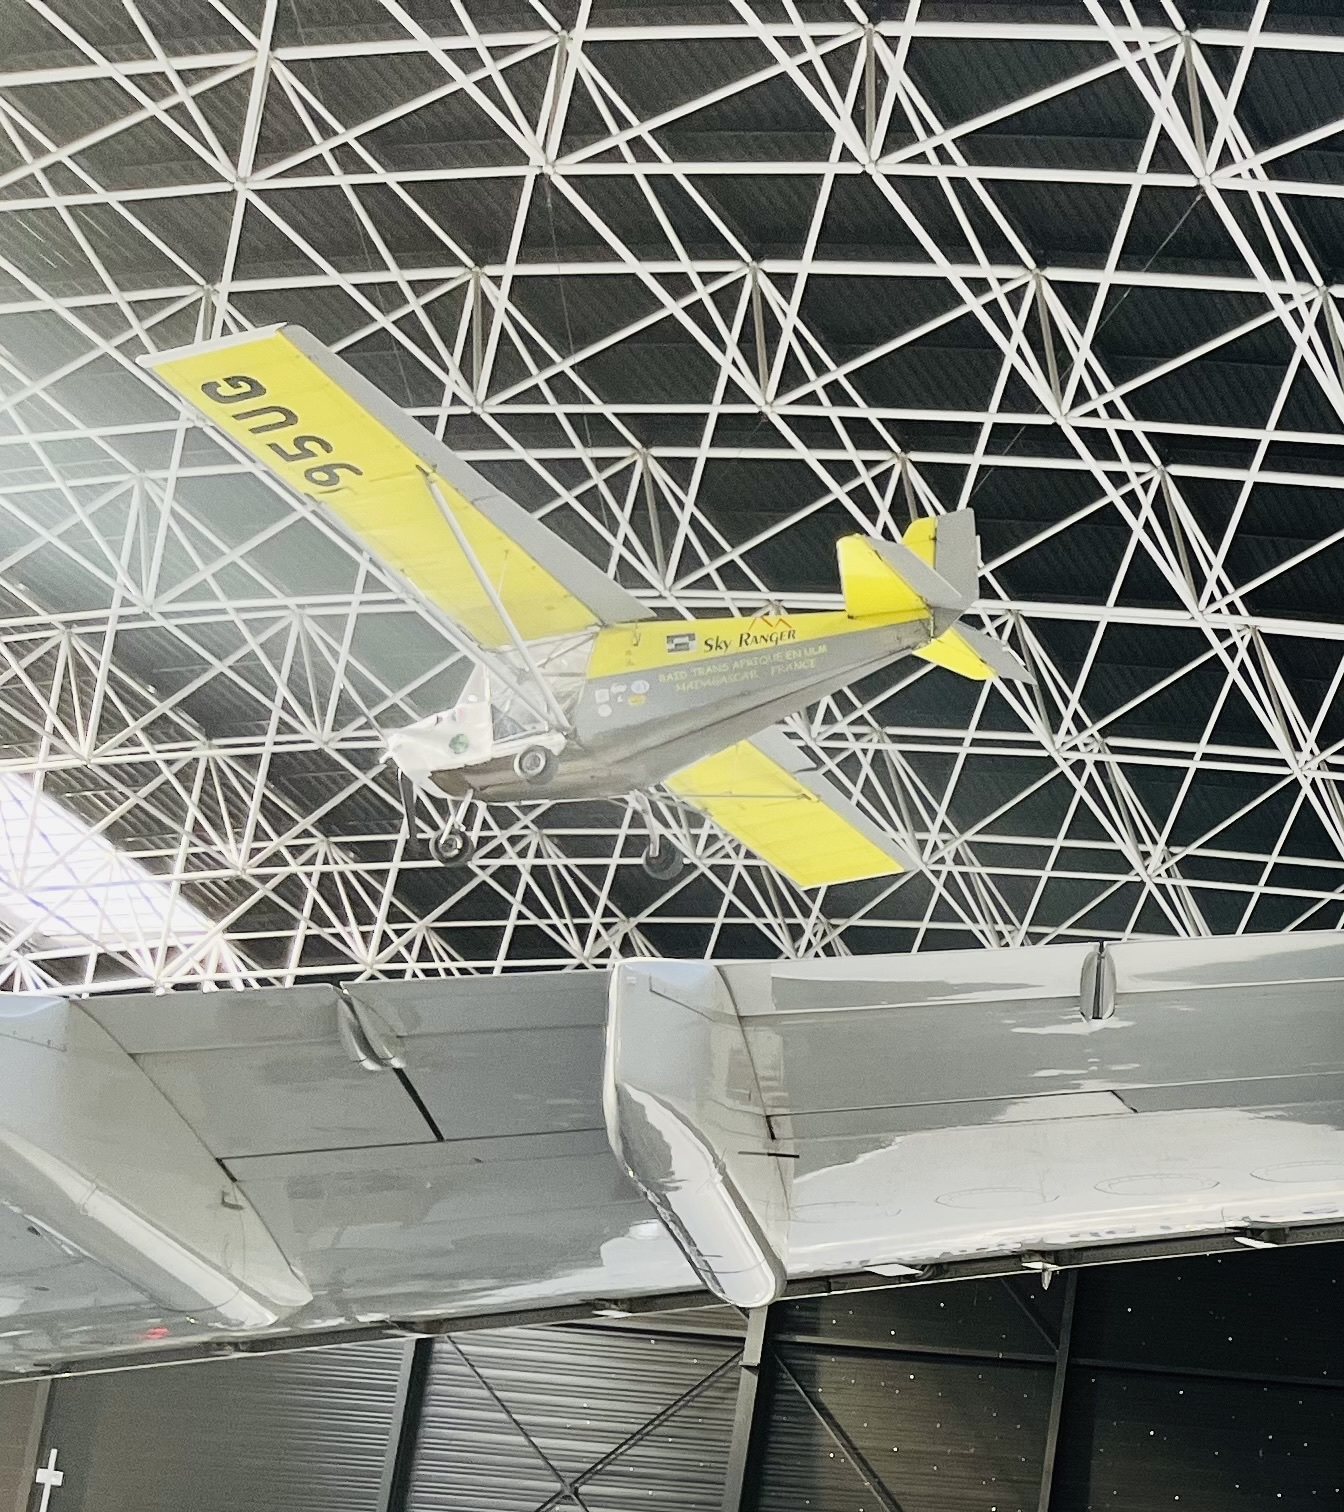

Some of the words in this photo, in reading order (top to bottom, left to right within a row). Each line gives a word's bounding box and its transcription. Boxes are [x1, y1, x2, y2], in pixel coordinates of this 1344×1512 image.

[201, 375, 363, 487] 95UG
[703, 635, 731, 653] Sky
[738, 629, 797, 648] RANGER
[692, 663, 729, 678] TRANS
[769, 657, 818, 676] FRANCE
